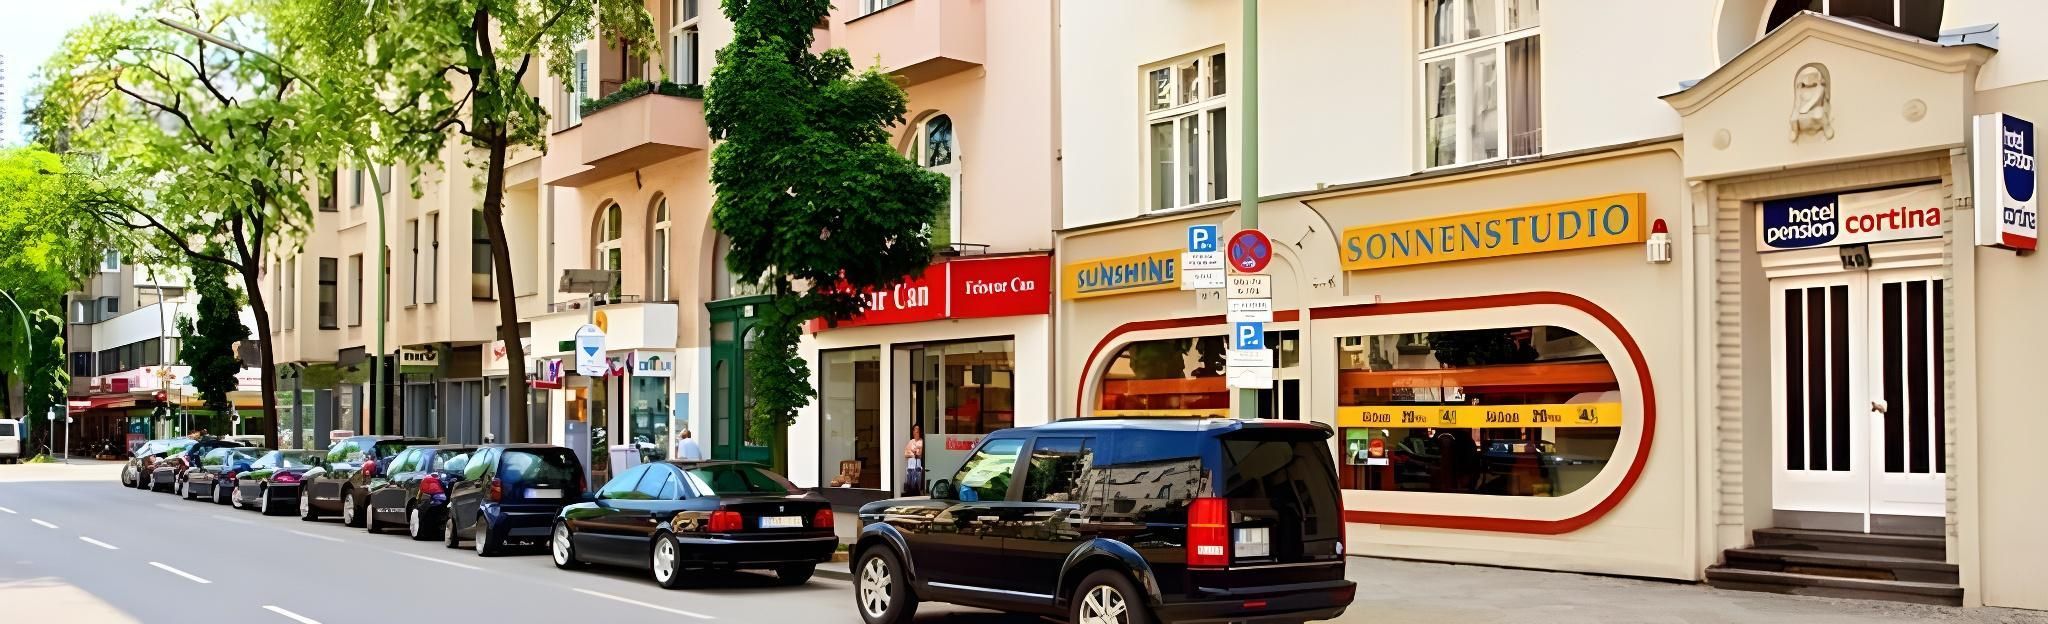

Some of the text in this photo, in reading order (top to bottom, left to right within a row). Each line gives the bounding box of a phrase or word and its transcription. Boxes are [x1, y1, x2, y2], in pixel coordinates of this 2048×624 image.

[1788, 202, 1835, 224] hotel
[1845, 206, 1941, 234] cortina
[1347, 204, 1629, 262] SONNENSTUDIO
[1767, 220, 1836, 244] pension
[1010, 276, 1035, 292] Can
[1077, 256, 1175, 289] SUNSHINE
